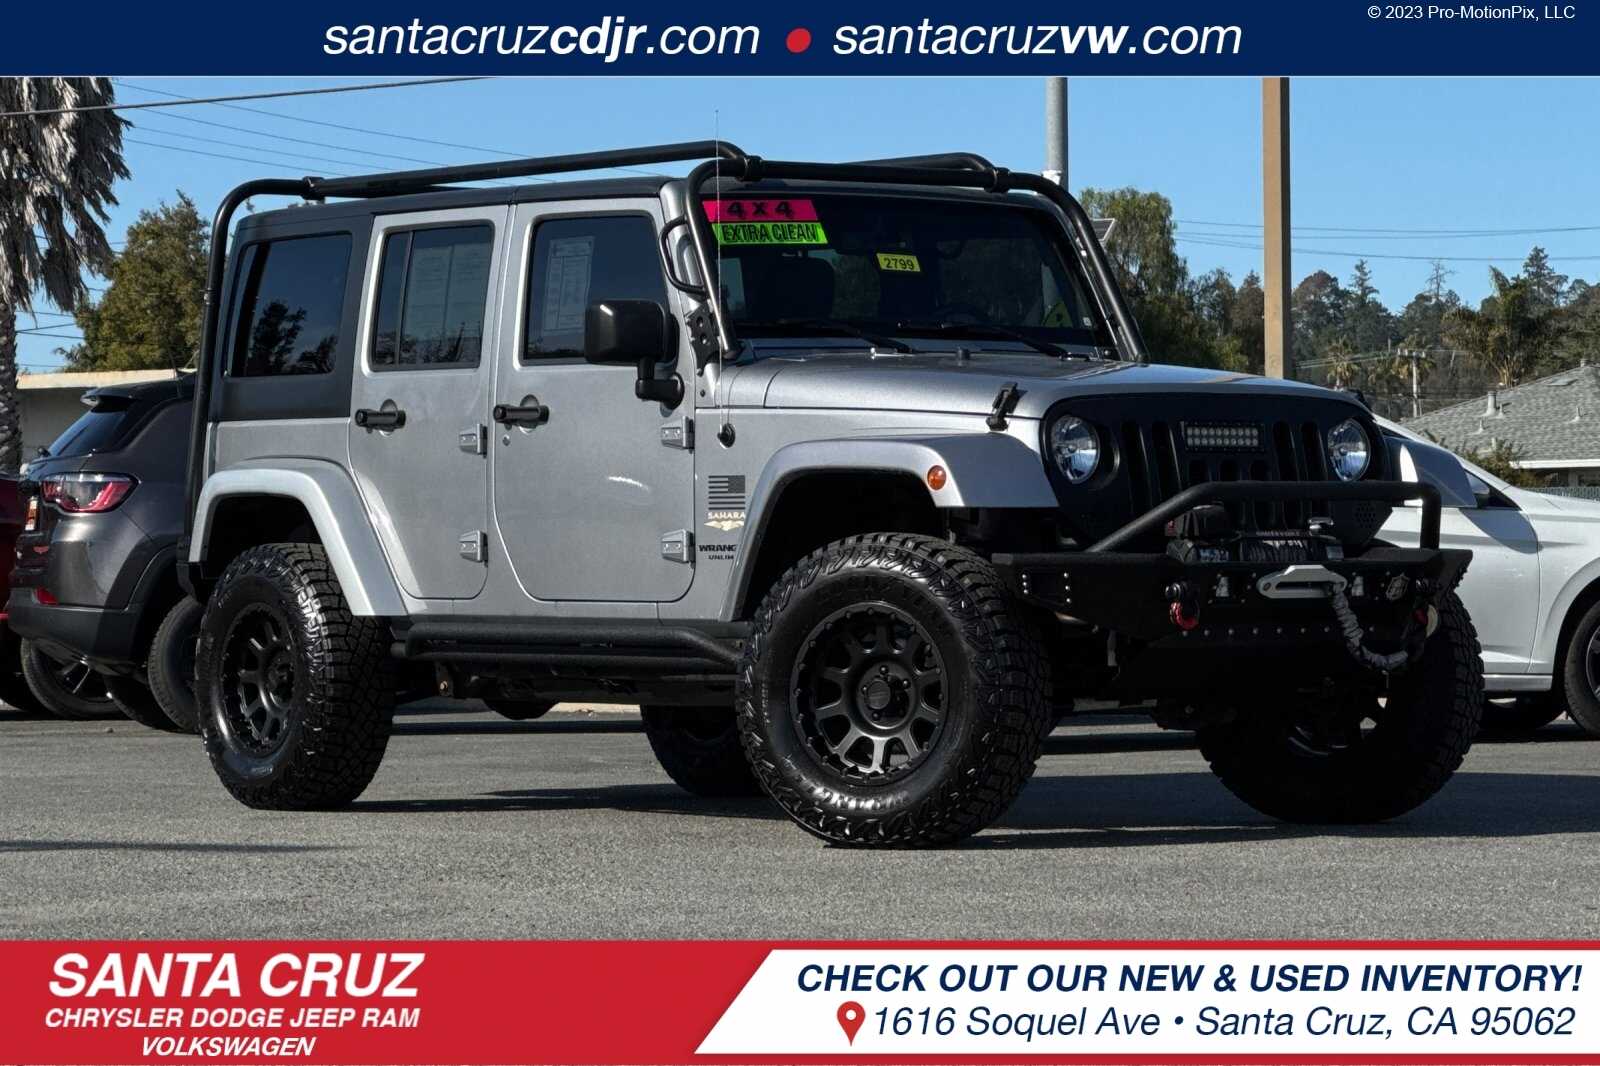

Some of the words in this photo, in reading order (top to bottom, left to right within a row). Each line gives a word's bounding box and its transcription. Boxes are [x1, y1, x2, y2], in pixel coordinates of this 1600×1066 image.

[722, 223, 770, 242] EXTRA
[771, 222, 818, 241] CLEAN
[883, 256, 915, 269] 2799
[707, 511, 746, 520] SAHARA
